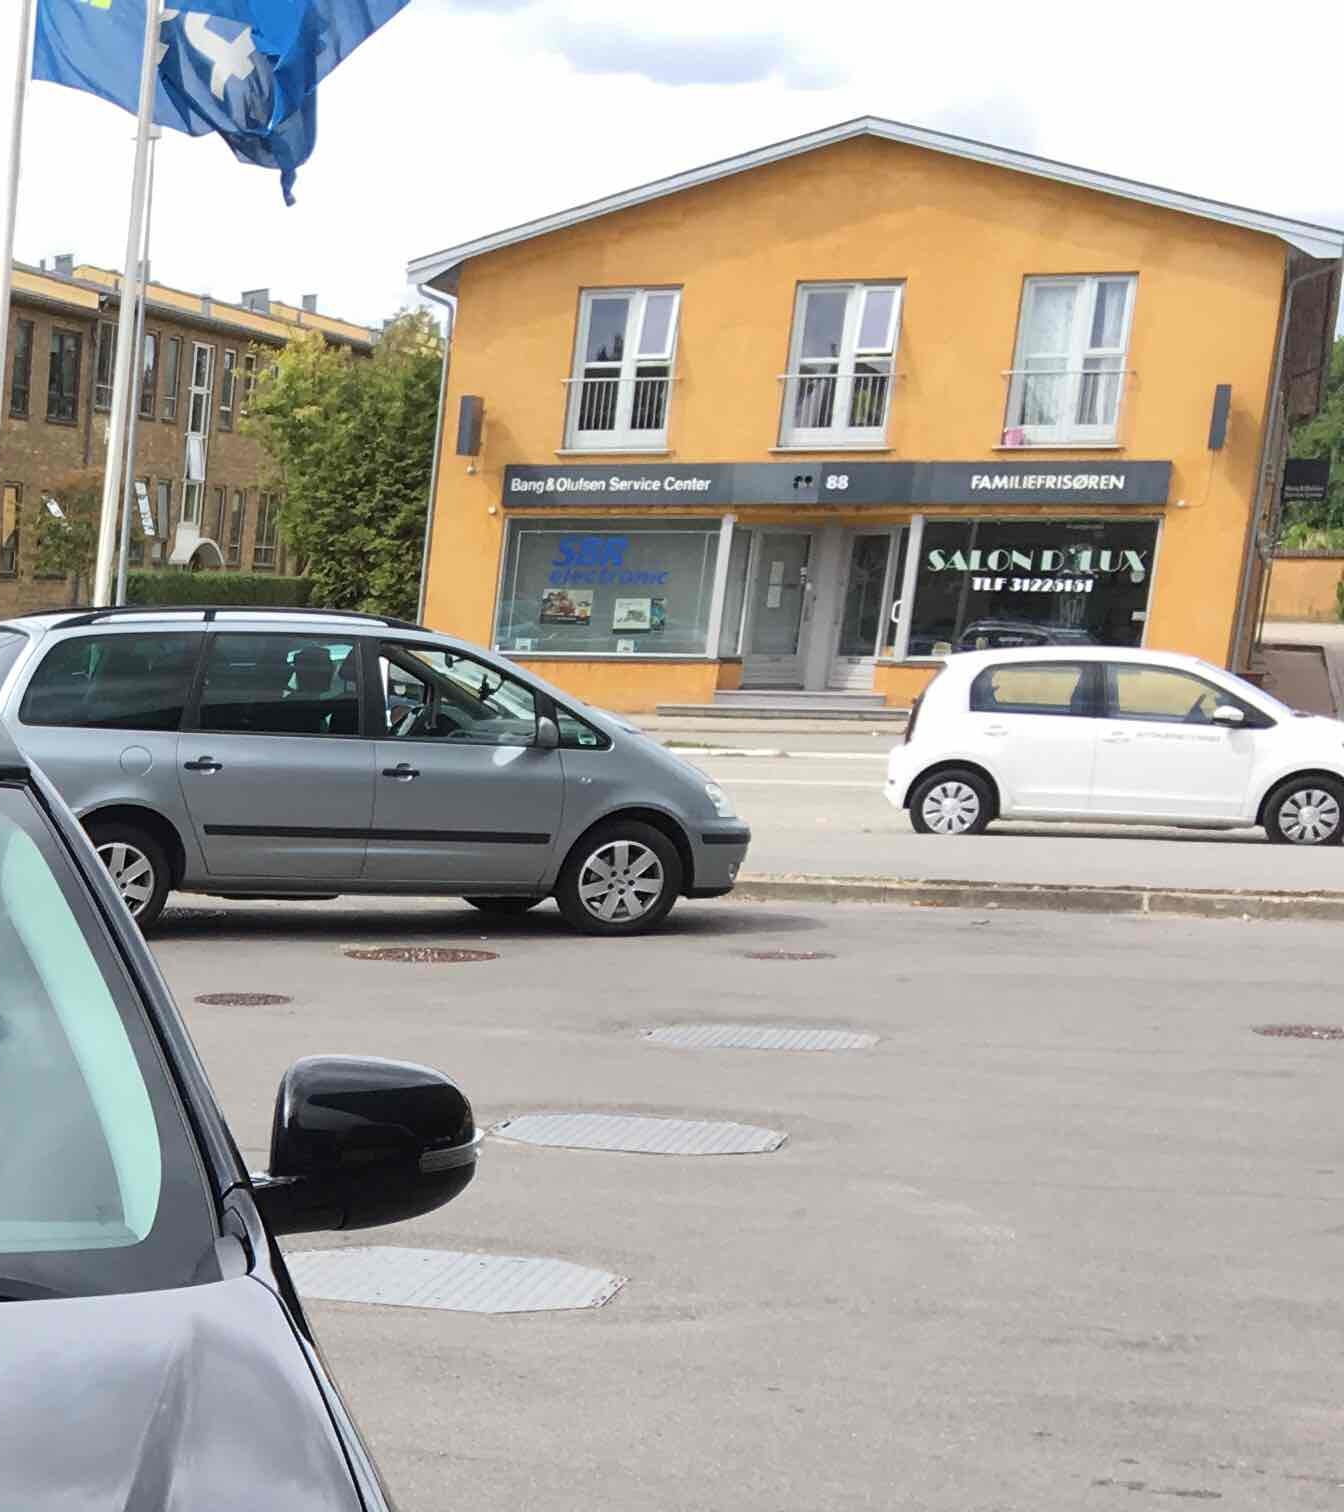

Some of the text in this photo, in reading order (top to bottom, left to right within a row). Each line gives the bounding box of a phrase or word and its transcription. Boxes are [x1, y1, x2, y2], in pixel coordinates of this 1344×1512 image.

[609, 476, 661, 491] Service
[663, 476, 712, 491] Center
[825, 474, 849, 490] 88
[970, 474, 1125, 490] FAMILIEFRISØREN
[927, 549, 1034, 572] SALON
[972, 576, 1007, 591] TLF
